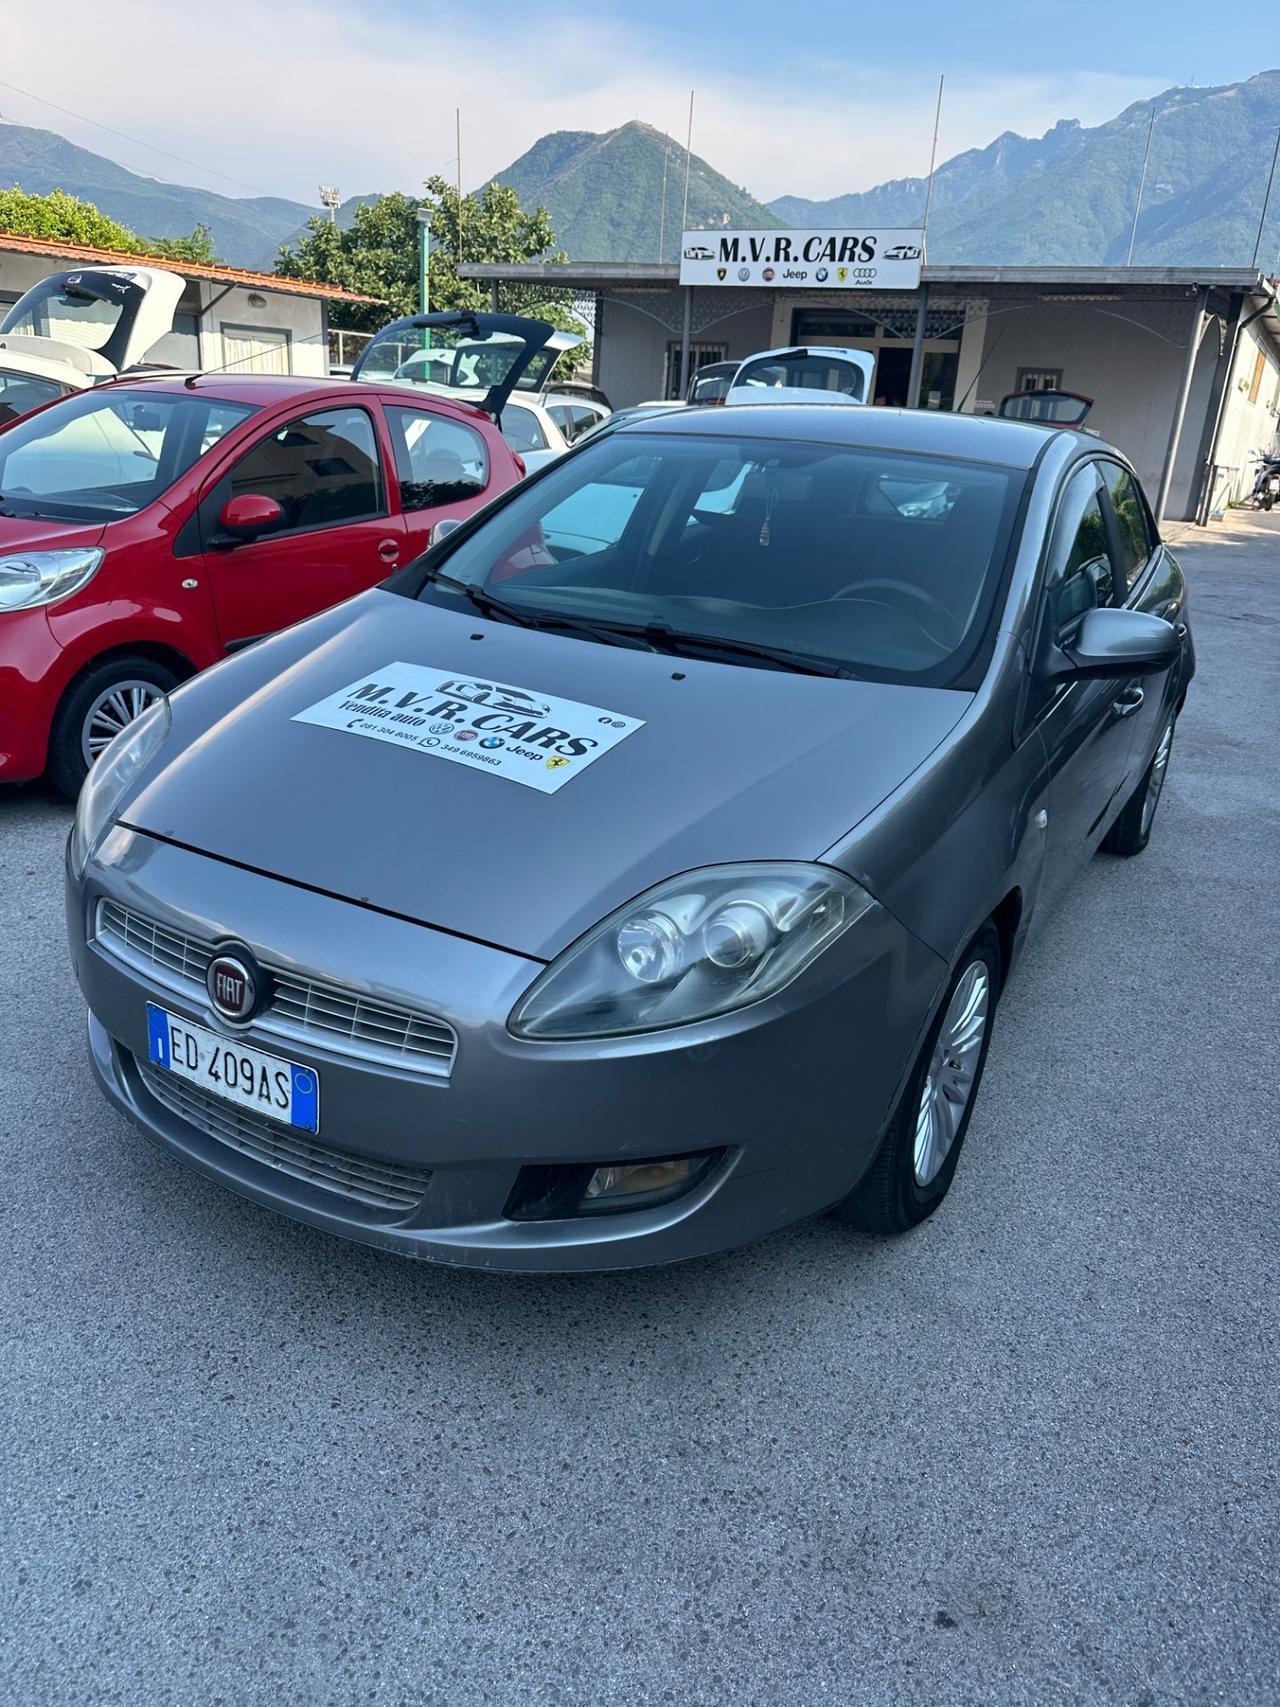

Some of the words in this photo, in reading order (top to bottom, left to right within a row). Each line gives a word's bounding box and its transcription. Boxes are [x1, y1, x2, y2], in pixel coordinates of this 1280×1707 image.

[783, 268, 807, 280] Jeep
[338, 700, 393, 719] Vendita
[389, 712, 427, 727] auto
[359, 722, 377, 731] 081
[440, 744, 460, 753] 349
[505, 745, 544, 762] Jeep
[216, 972, 243, 1005] FIAT
[170, 1026, 199, 1070] ED
[208, 1046, 289, 1109] 409AS
